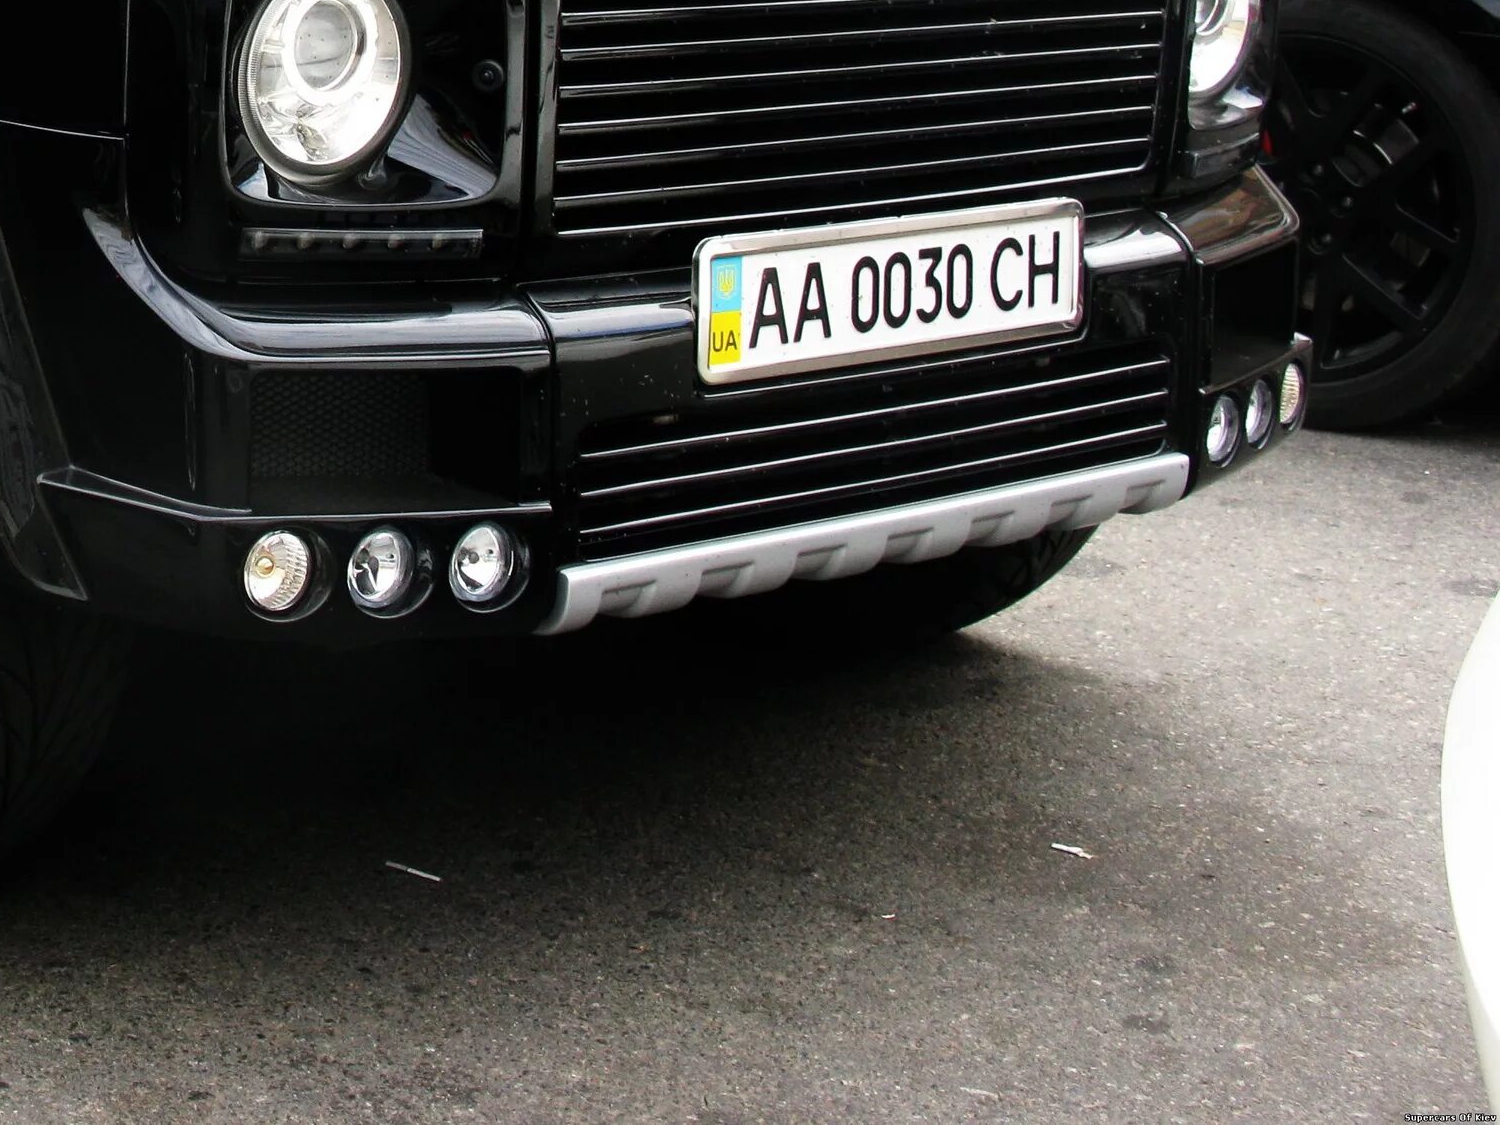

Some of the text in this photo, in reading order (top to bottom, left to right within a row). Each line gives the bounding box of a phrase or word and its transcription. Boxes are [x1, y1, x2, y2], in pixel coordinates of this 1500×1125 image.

[712, 230, 1060, 353] UA AA 0030 CH
